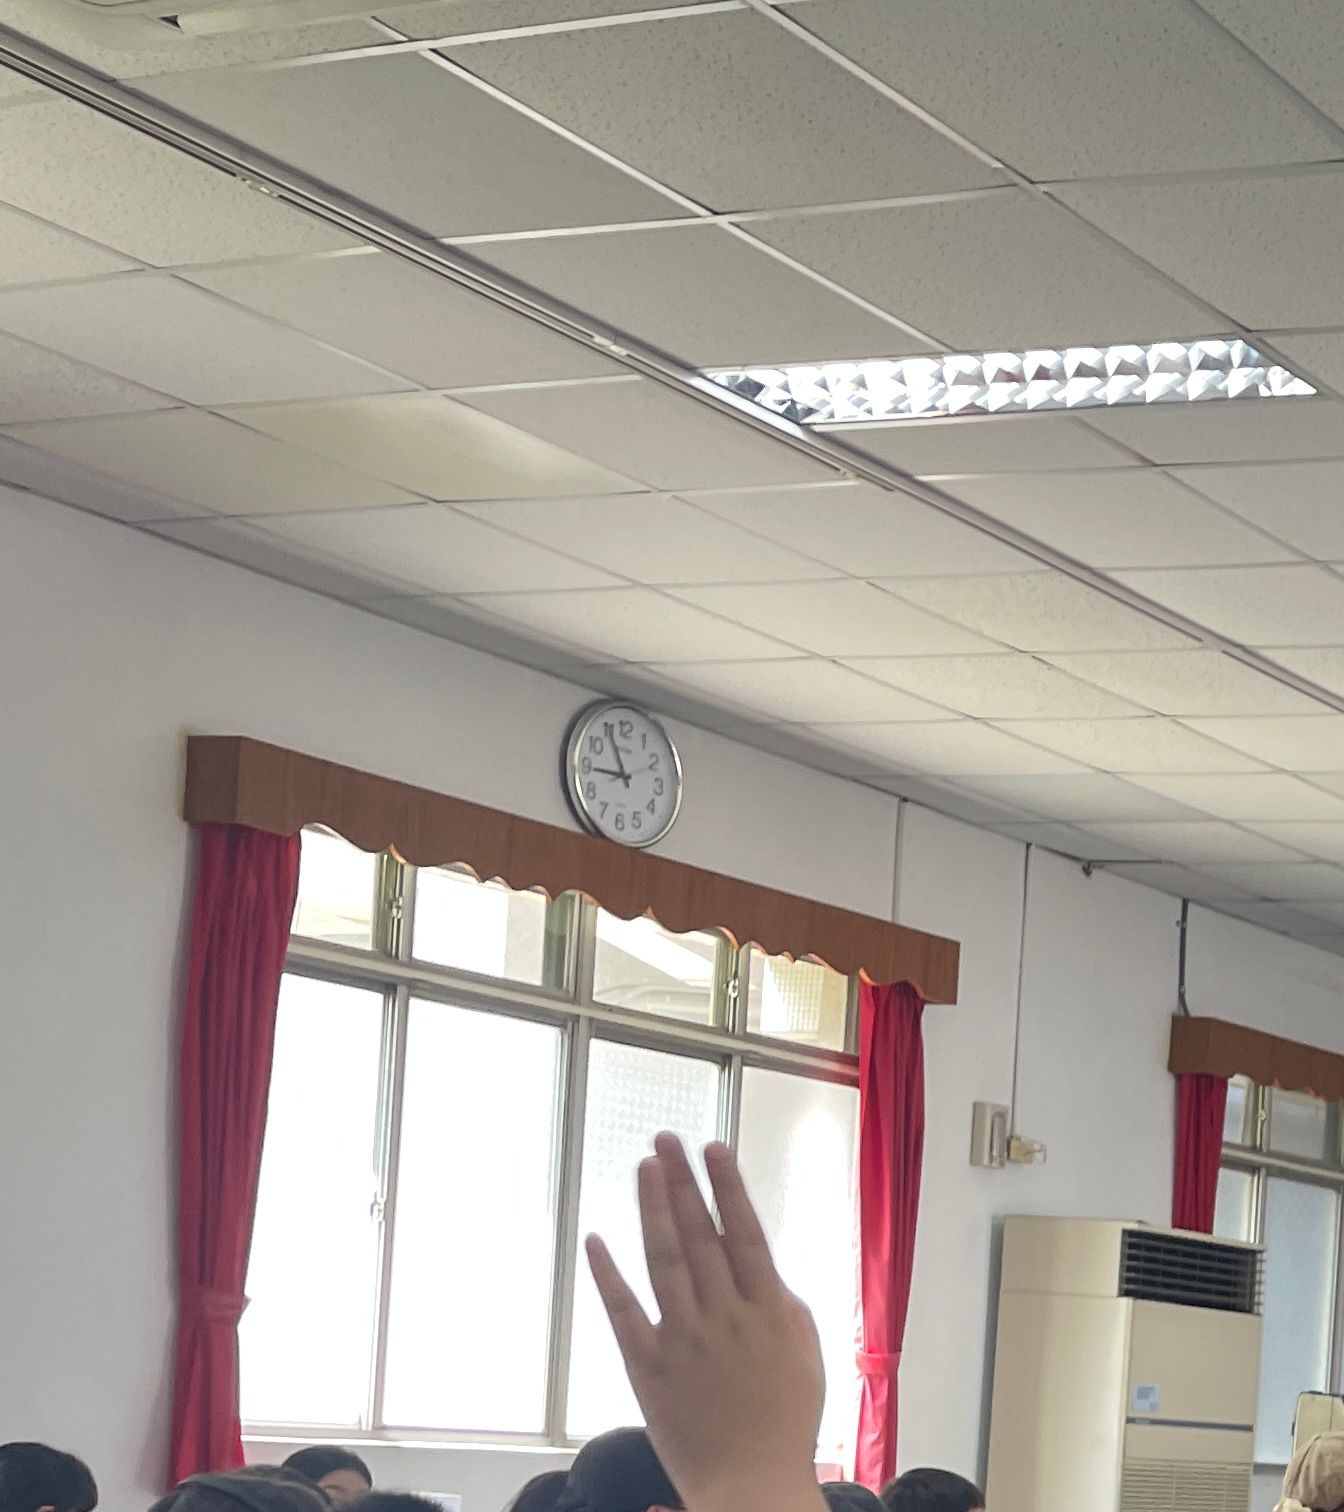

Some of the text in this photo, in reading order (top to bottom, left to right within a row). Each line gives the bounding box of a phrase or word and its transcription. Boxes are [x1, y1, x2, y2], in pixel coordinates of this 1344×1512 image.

[620, 720, 634, 739] 12
[589, 735, 604, 755] 10
[641, 733, 647, 750] 1
[582, 756, 592, 775] 9
[648, 752, 659, 771] 2
[586, 781, 596, 800] 8
[653, 777, 664, 796] 3
[600, 801, 609, 819] 7
[646, 799, 656, 815] 4
[614, 812, 625, 831] 6
[631, 810, 642, 829] 5
